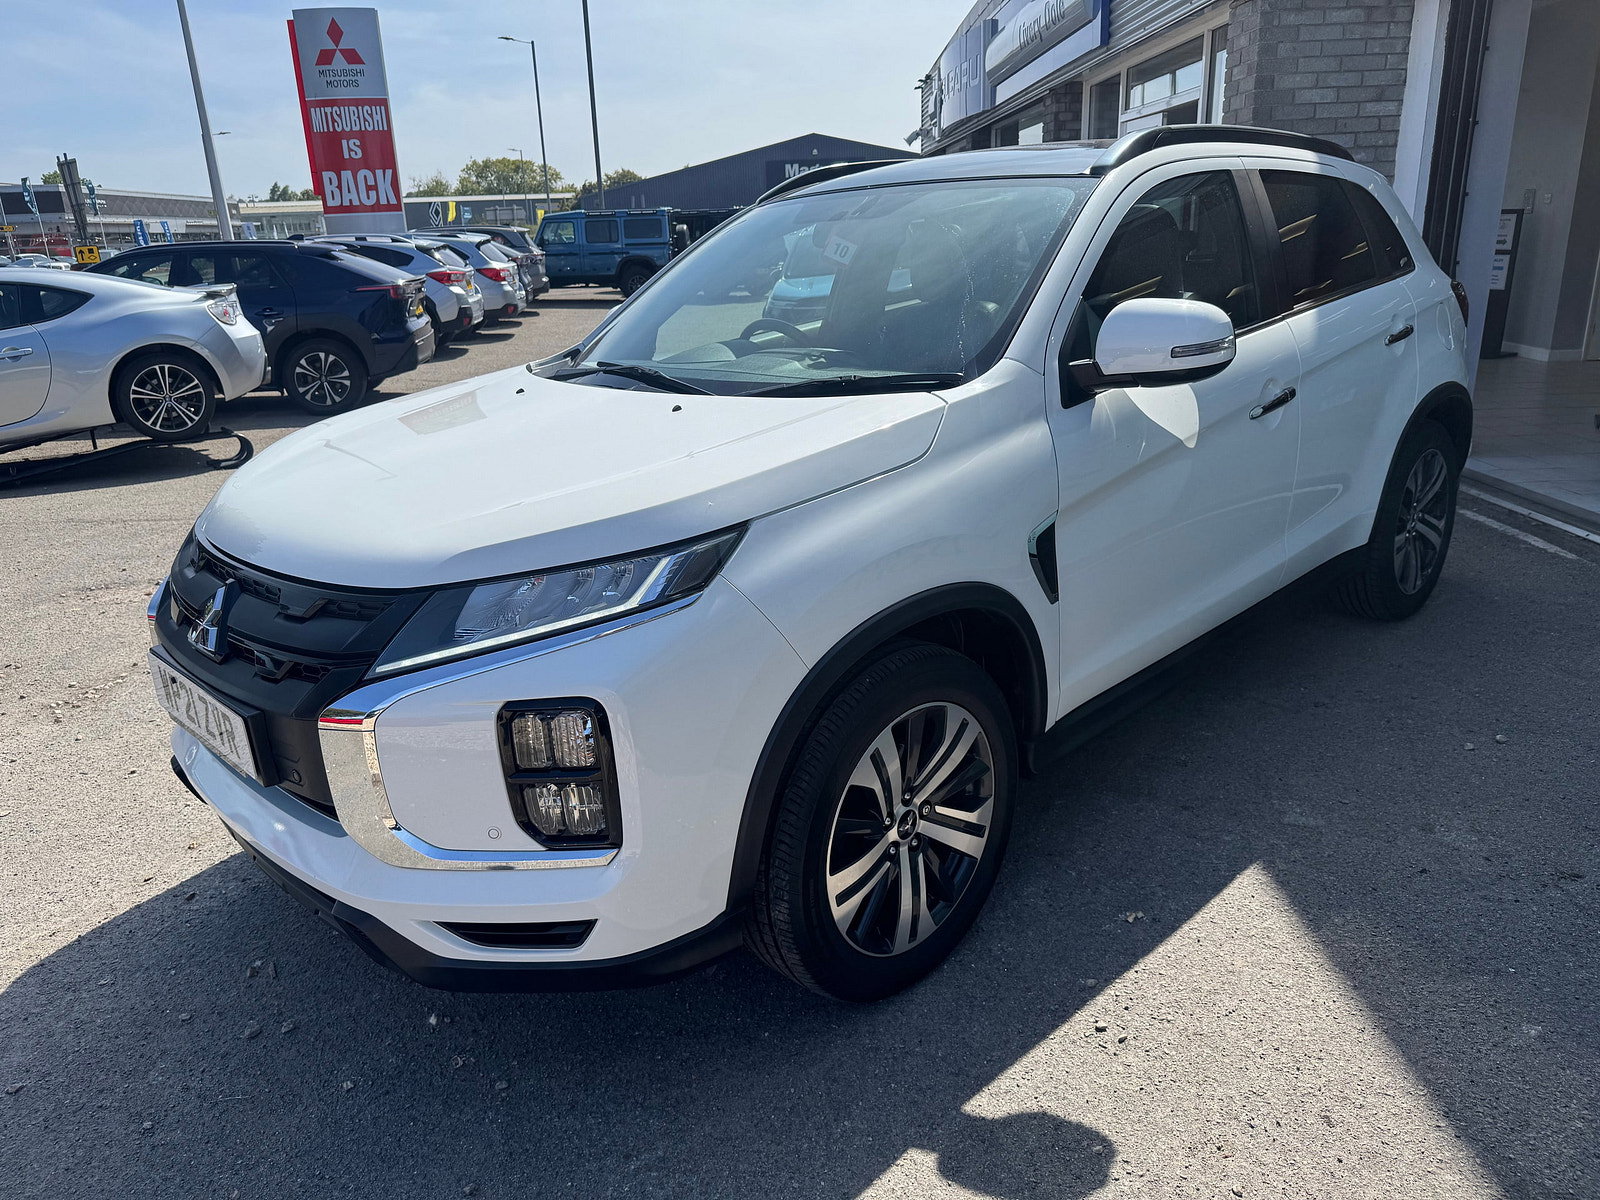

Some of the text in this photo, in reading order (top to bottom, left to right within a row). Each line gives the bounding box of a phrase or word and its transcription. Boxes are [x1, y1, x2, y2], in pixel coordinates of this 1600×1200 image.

[318, 68, 365, 78] MITSUBISHI
[326, 79, 360, 88] MOTORS
[310, 105, 388, 133] MITSUBISHI
[341, 138, 363, 159] IS
[321, 168, 398, 207] BACK
[834, 242, 849, 259] 10
